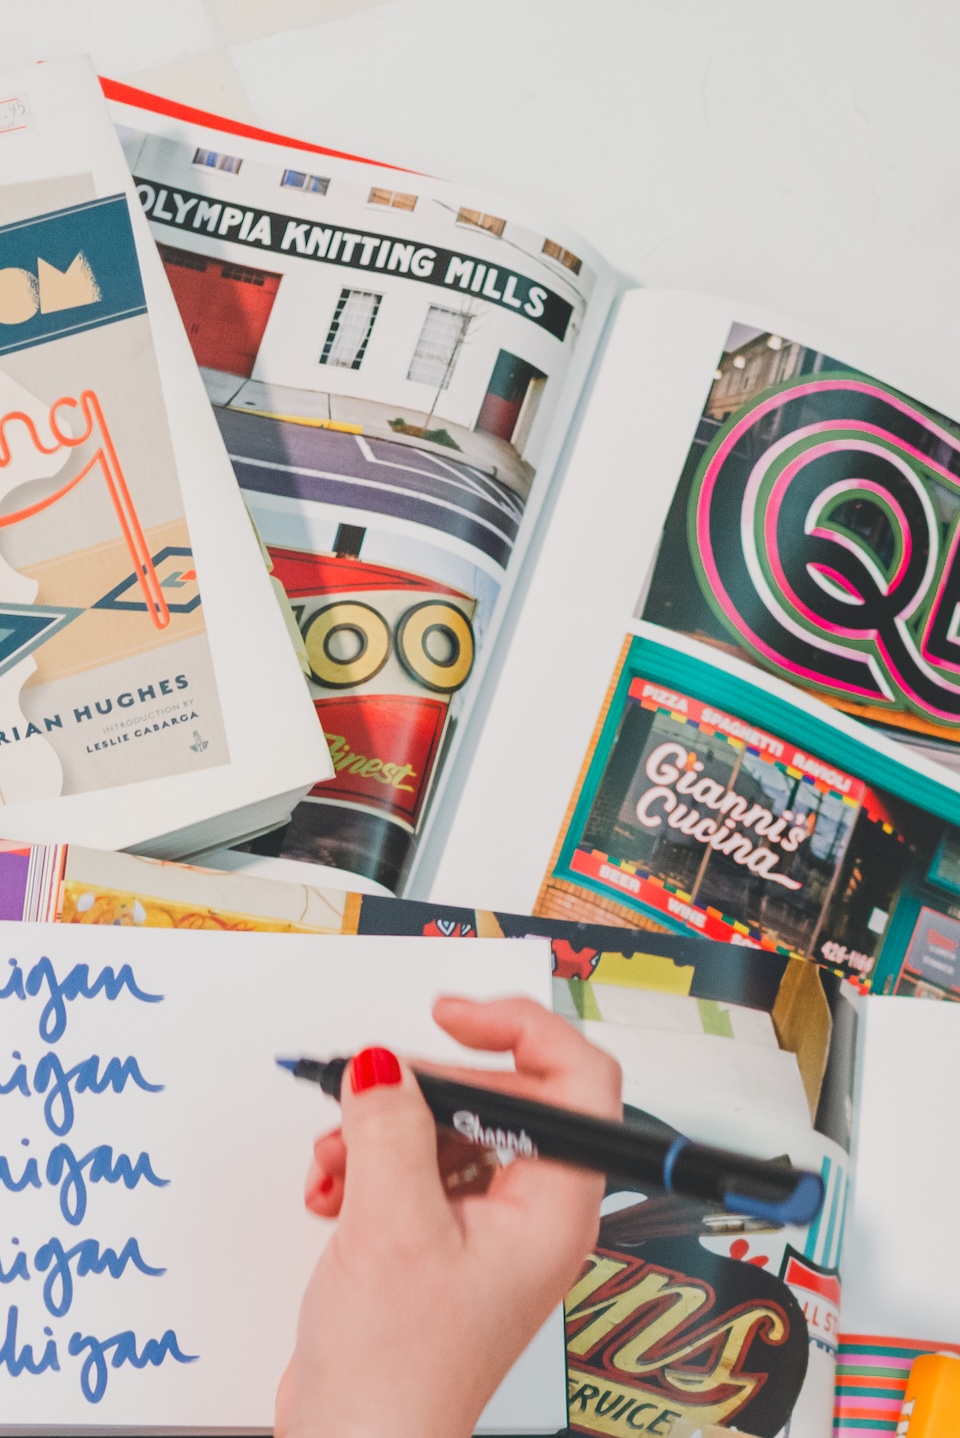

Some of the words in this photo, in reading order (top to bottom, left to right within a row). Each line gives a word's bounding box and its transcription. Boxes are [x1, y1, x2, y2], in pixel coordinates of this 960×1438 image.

[135, 184, 272, 246] OLYMPIA
[280, 220, 437, 277] KNITTING
[444, 256, 548, 318] MILLS
[73, 674, 190, 723] HUGHES
[86, 733, 130, 753] LESLIE
[134, 712, 200, 738] CABARGA
[102, 704, 181, 735] INTRODUCTION
[183, 698, 195, 709] BY
[641, 684, 688, 713] PIZZA
[700, 708, 784, 757] SPAGHETTI
[791, 752, 853, 793] RAVIOLI
[645, 742, 808, 851] Gianni's
[636, 785, 803, 890] Cucina
[599, 864, 642, 895] BEER
